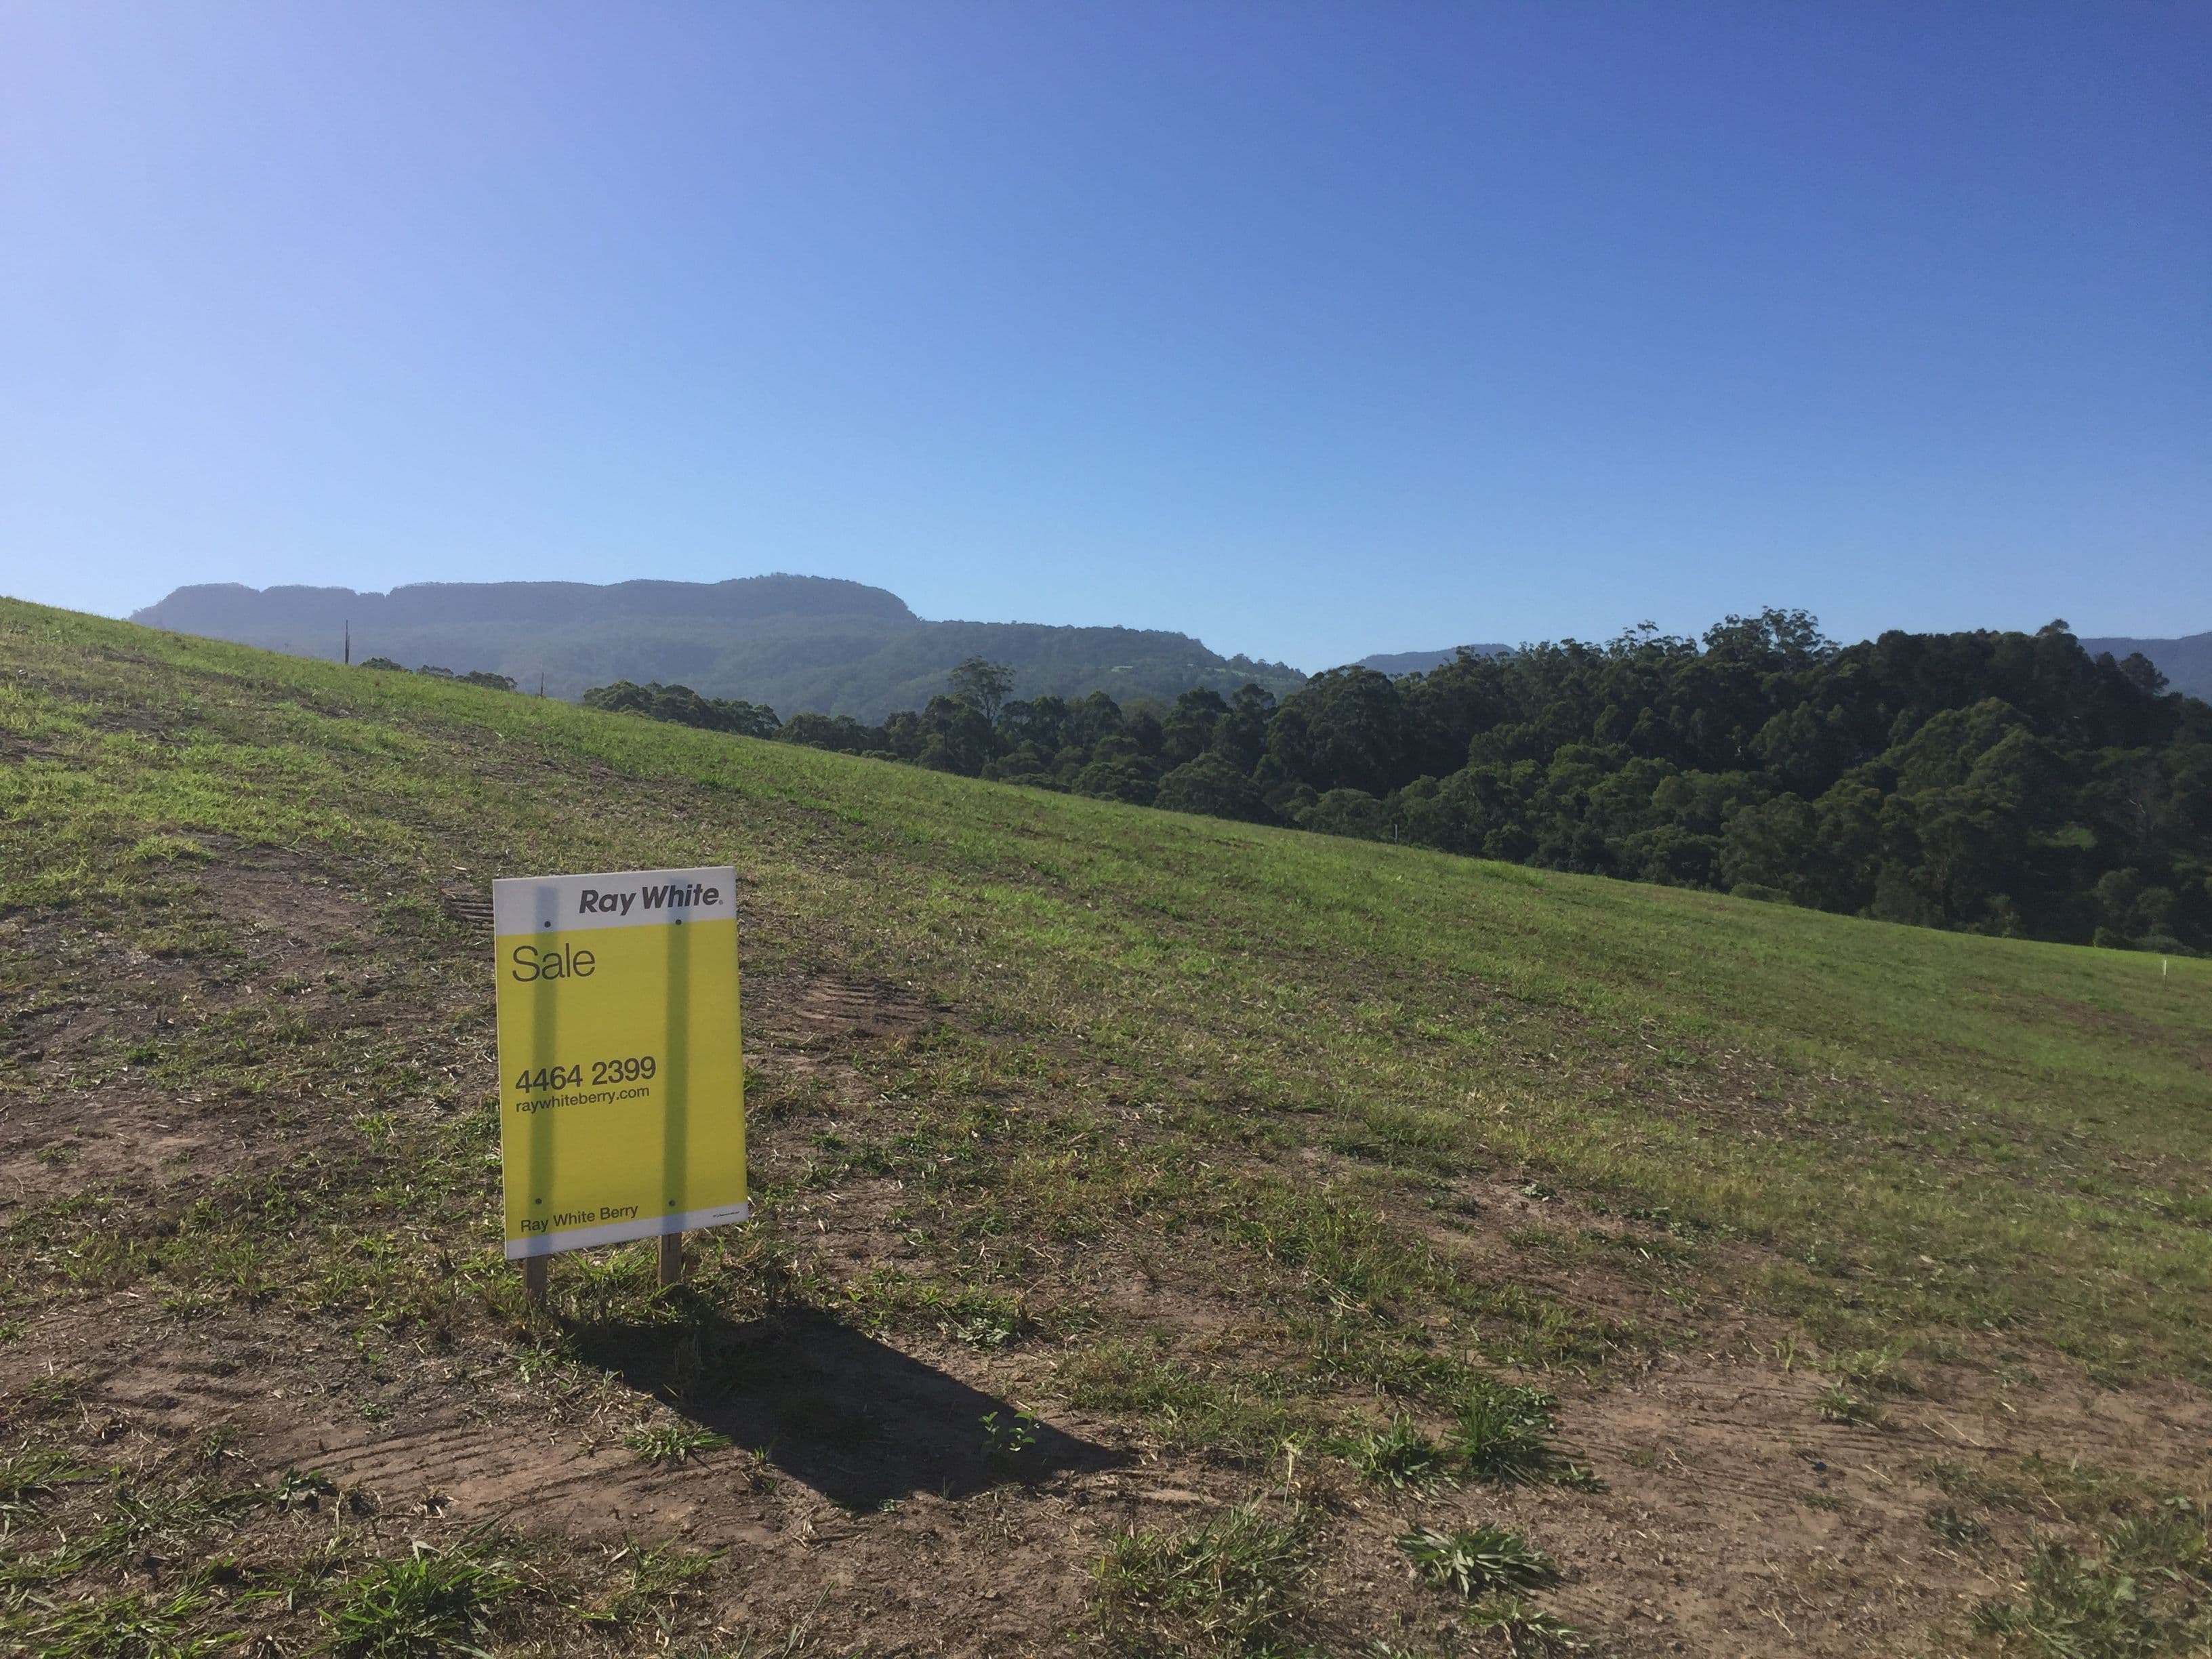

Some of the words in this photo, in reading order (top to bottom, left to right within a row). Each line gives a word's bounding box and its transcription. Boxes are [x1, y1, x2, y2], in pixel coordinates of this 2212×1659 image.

[579, 889, 636, 916] Ray
[642, 883, 720, 909] White
[512, 943, 596, 982] Sale
[515, 1064, 583, 1094] 4464
[592, 1056, 657, 1085] 2399
[516, 1086, 649, 1114] raywhiteberry.com
[520, 1218, 548, 1232] Ray
[553, 1210, 595, 1227] White
[600, 1205, 638, 1220] Berry
